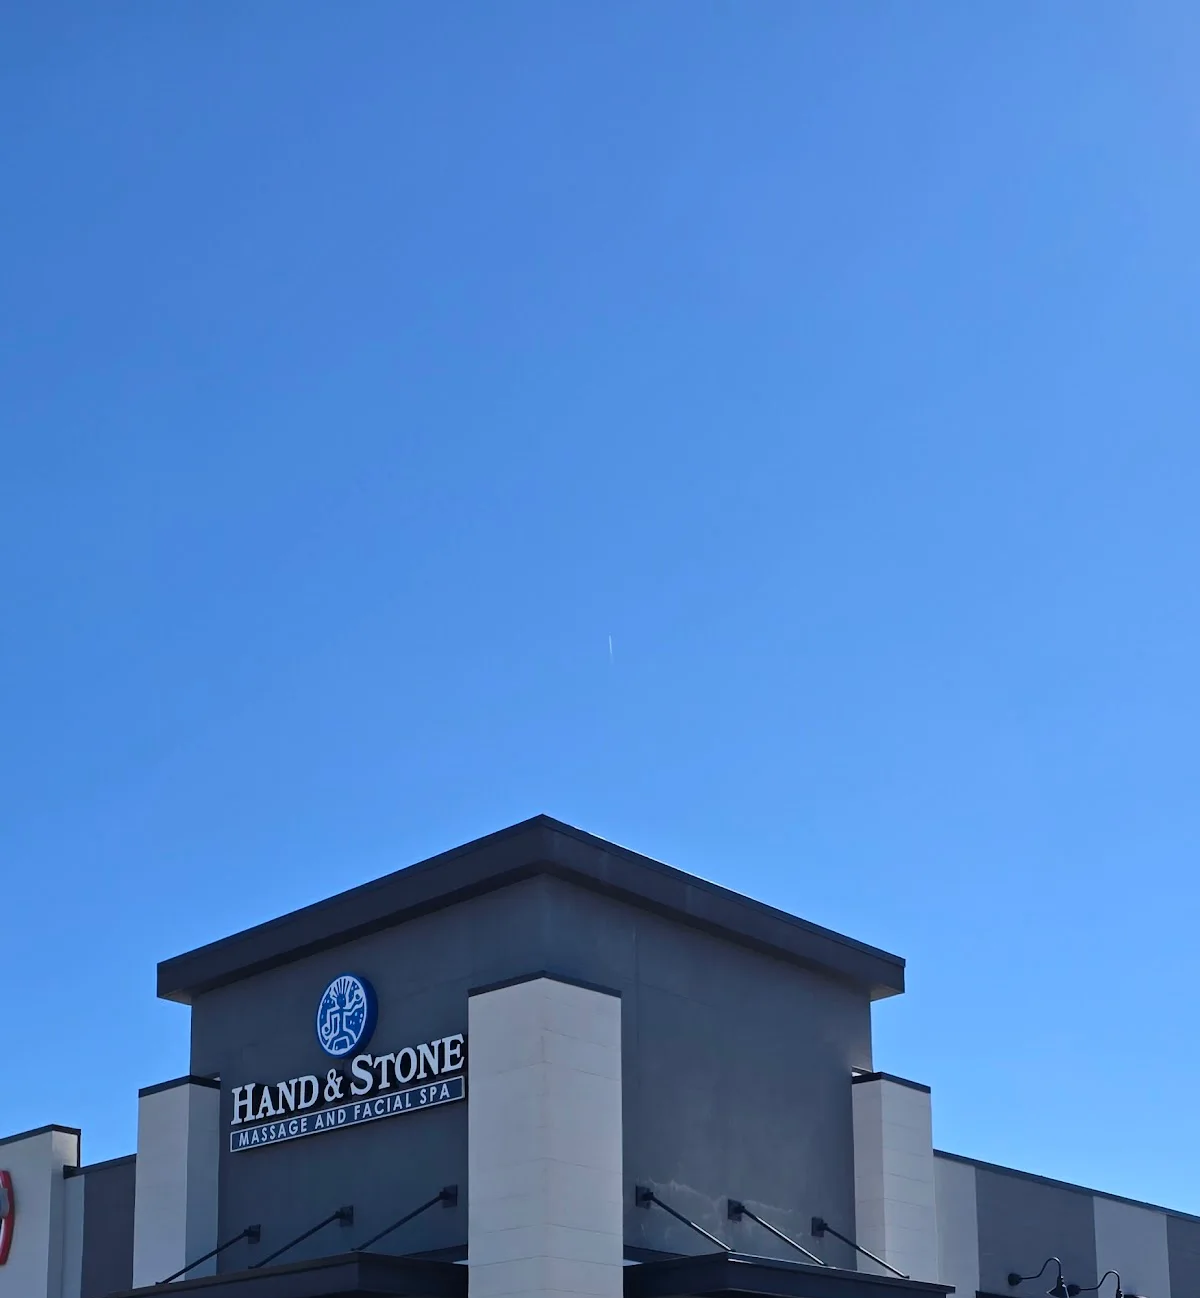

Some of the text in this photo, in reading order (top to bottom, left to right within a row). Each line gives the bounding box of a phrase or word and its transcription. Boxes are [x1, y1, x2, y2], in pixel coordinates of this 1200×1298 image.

[231, 1033, 465, 1125] HAND & STONE
[238, 1083, 450, 1147] MASSAGE AND FACIAL SPA
